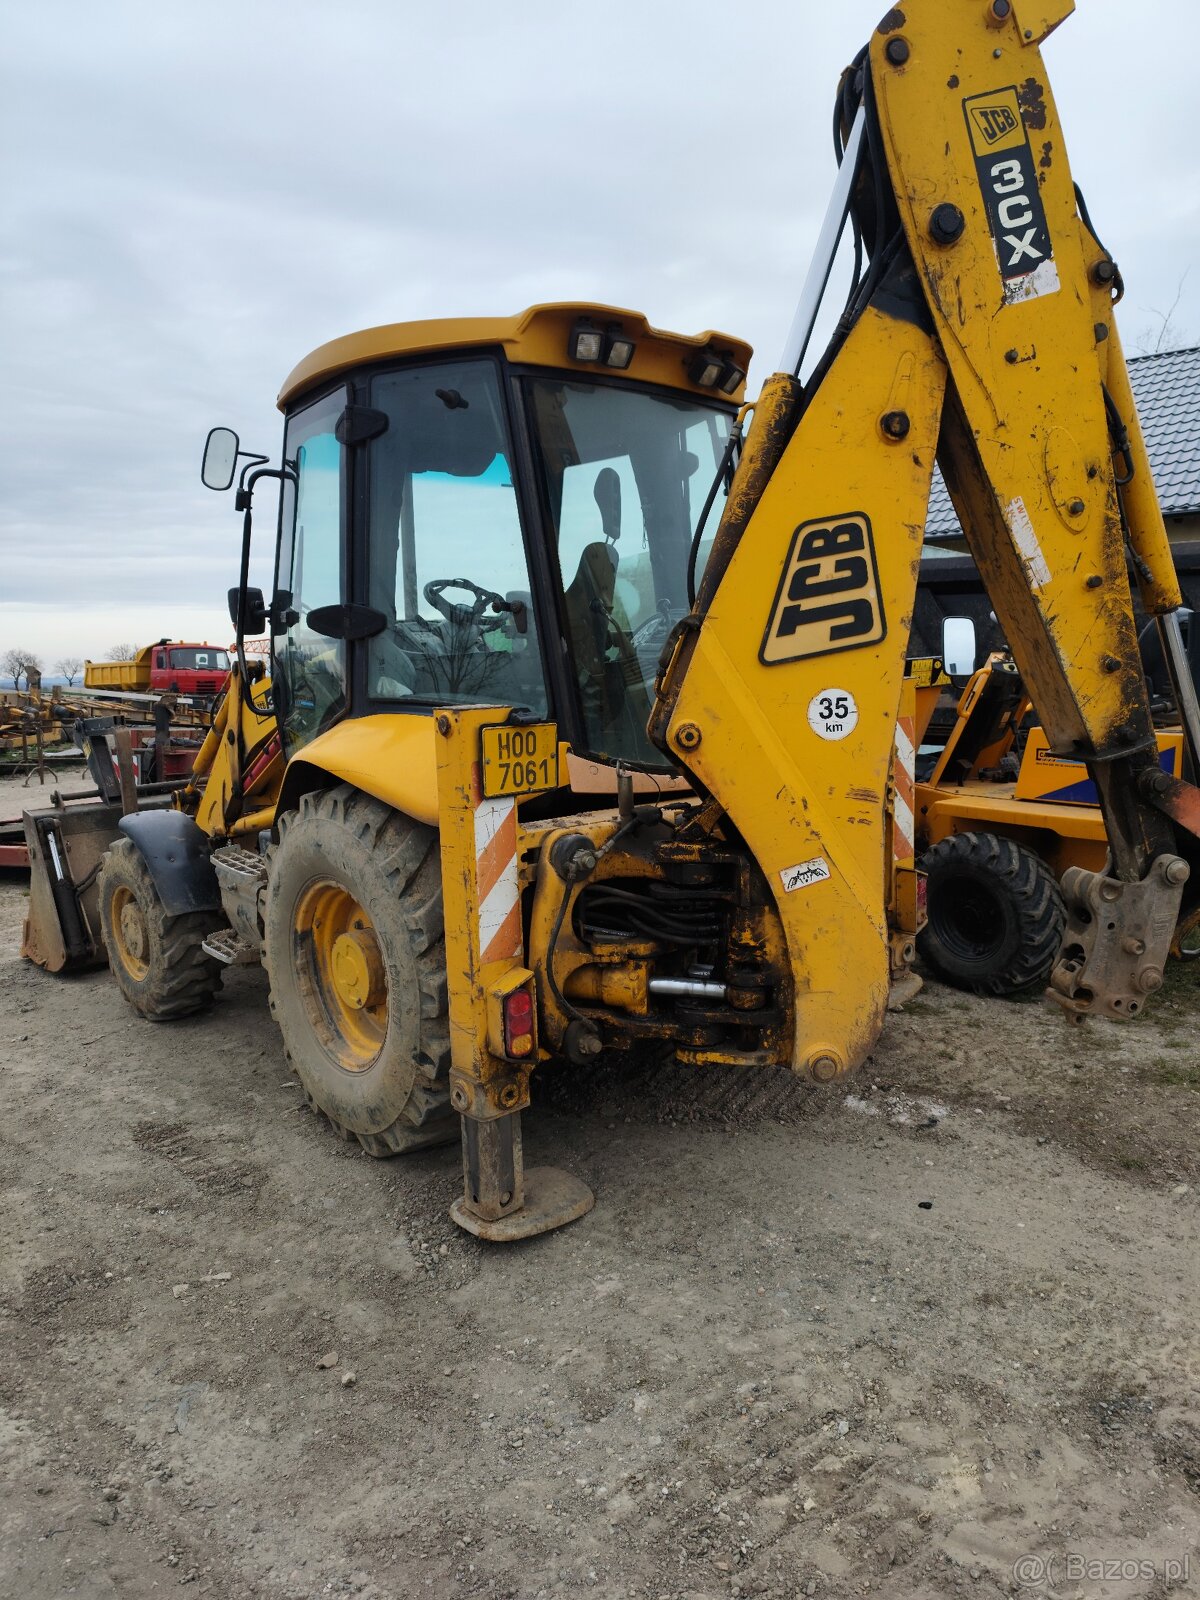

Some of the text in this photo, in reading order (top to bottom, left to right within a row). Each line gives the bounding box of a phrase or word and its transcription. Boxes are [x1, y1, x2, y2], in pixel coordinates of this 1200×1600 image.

[979, 107, 1016, 140] JCB
[990, 159, 1043, 266] 3CX
[776, 522, 874, 642] JCB
[818, 697, 849, 719] 35
[825, 723, 843, 732] km
[498, 759, 548, 790] 7061
